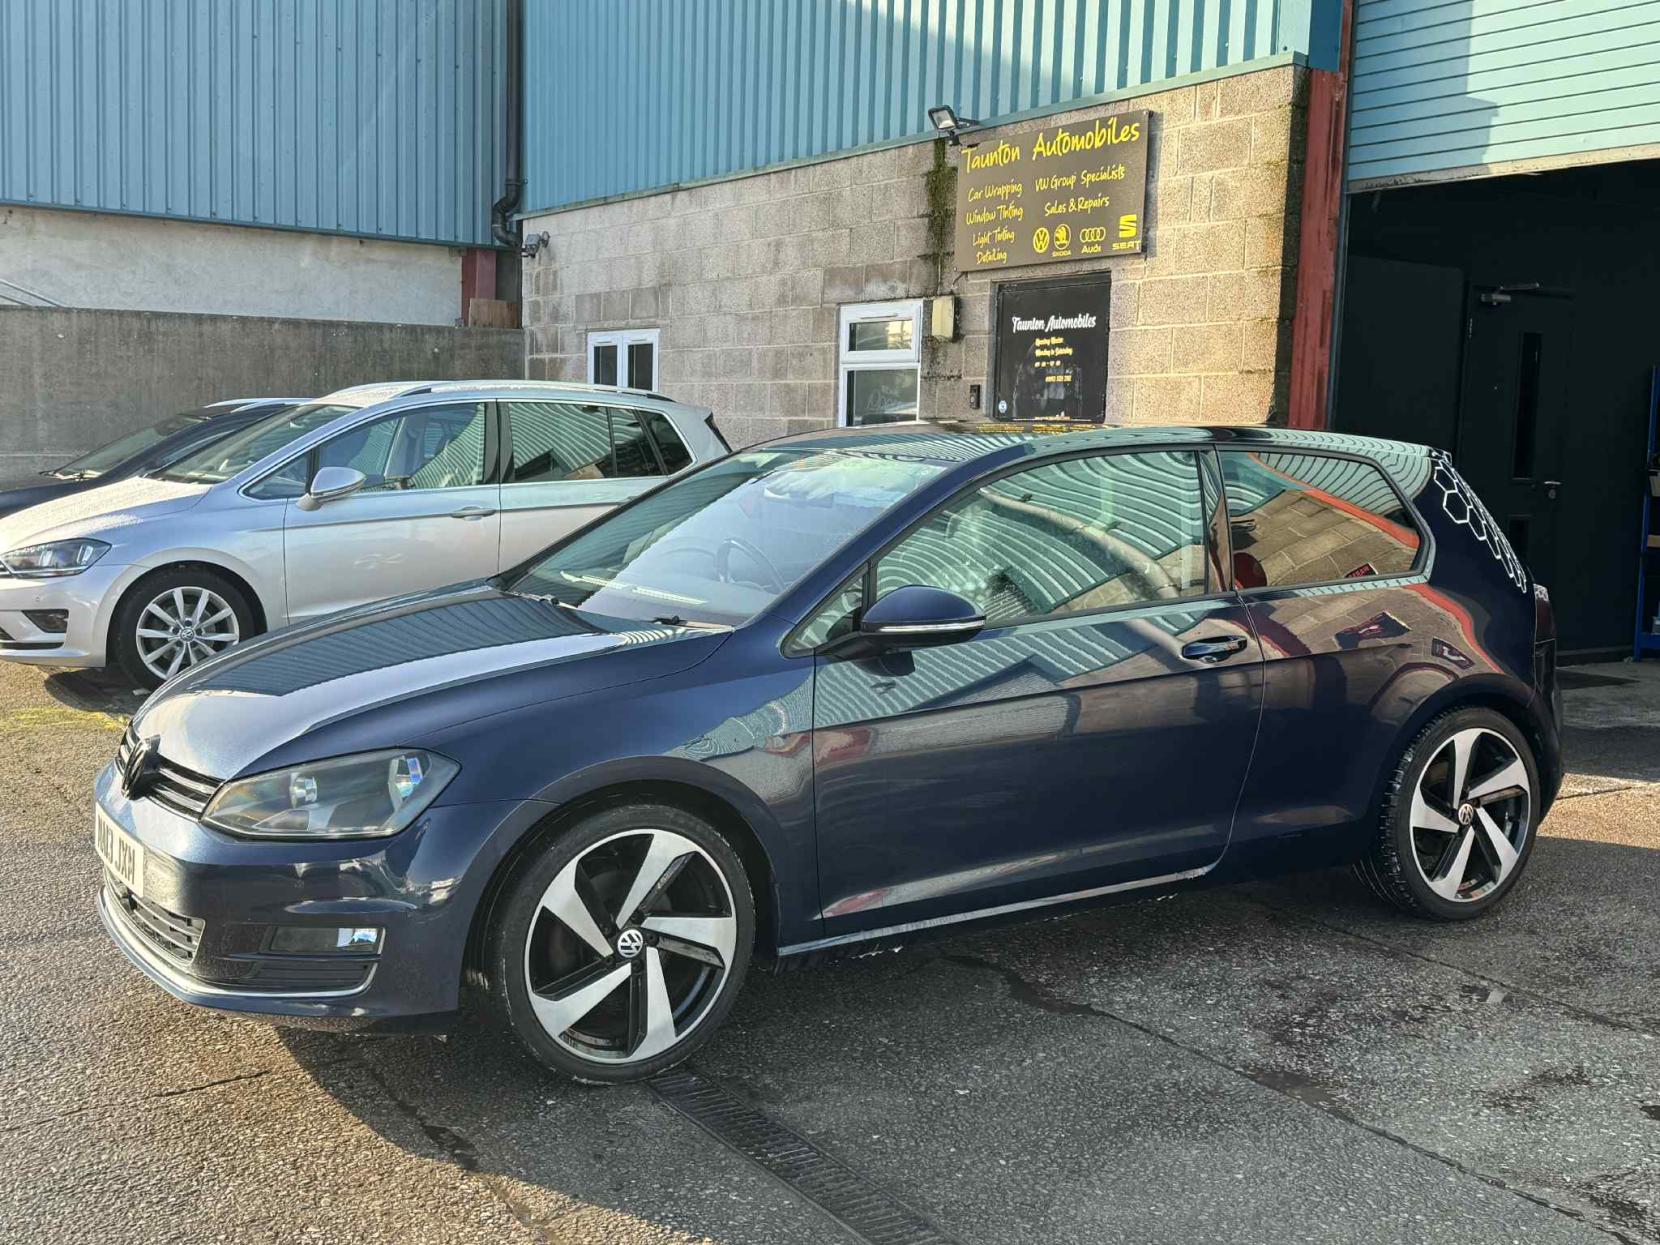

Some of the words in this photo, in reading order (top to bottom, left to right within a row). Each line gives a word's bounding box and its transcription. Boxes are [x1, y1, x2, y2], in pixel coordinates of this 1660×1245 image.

[961, 140, 1021, 174] Taunton
[1032, 116, 1141, 161] Automobiles
[968, 187, 984, 202] Car
[984, 177, 1023, 200] Wrapping
[1035, 177, 1049, 192] VW
[1050, 174, 1077, 190] Group
[1080, 163, 1126, 188] Specialists
[966, 206, 996, 225] Window
[996, 200, 1024, 221] Tinting
[1044, 199, 1067, 217] Sales
[1068, 198, 1077, 213] &
[1077, 192, 1110, 215] Repairs
[972, 231, 992, 249] Light
[992, 225, 1015, 244] Tinting
[1081, 244, 1102, 254] Audi
[1111, 240, 1142, 251] SEAT
[976, 248, 1007, 265] Detailing
[1011, 316, 1046, 334] Taunton
[1044, 312, 1097, 333] Automobiles
